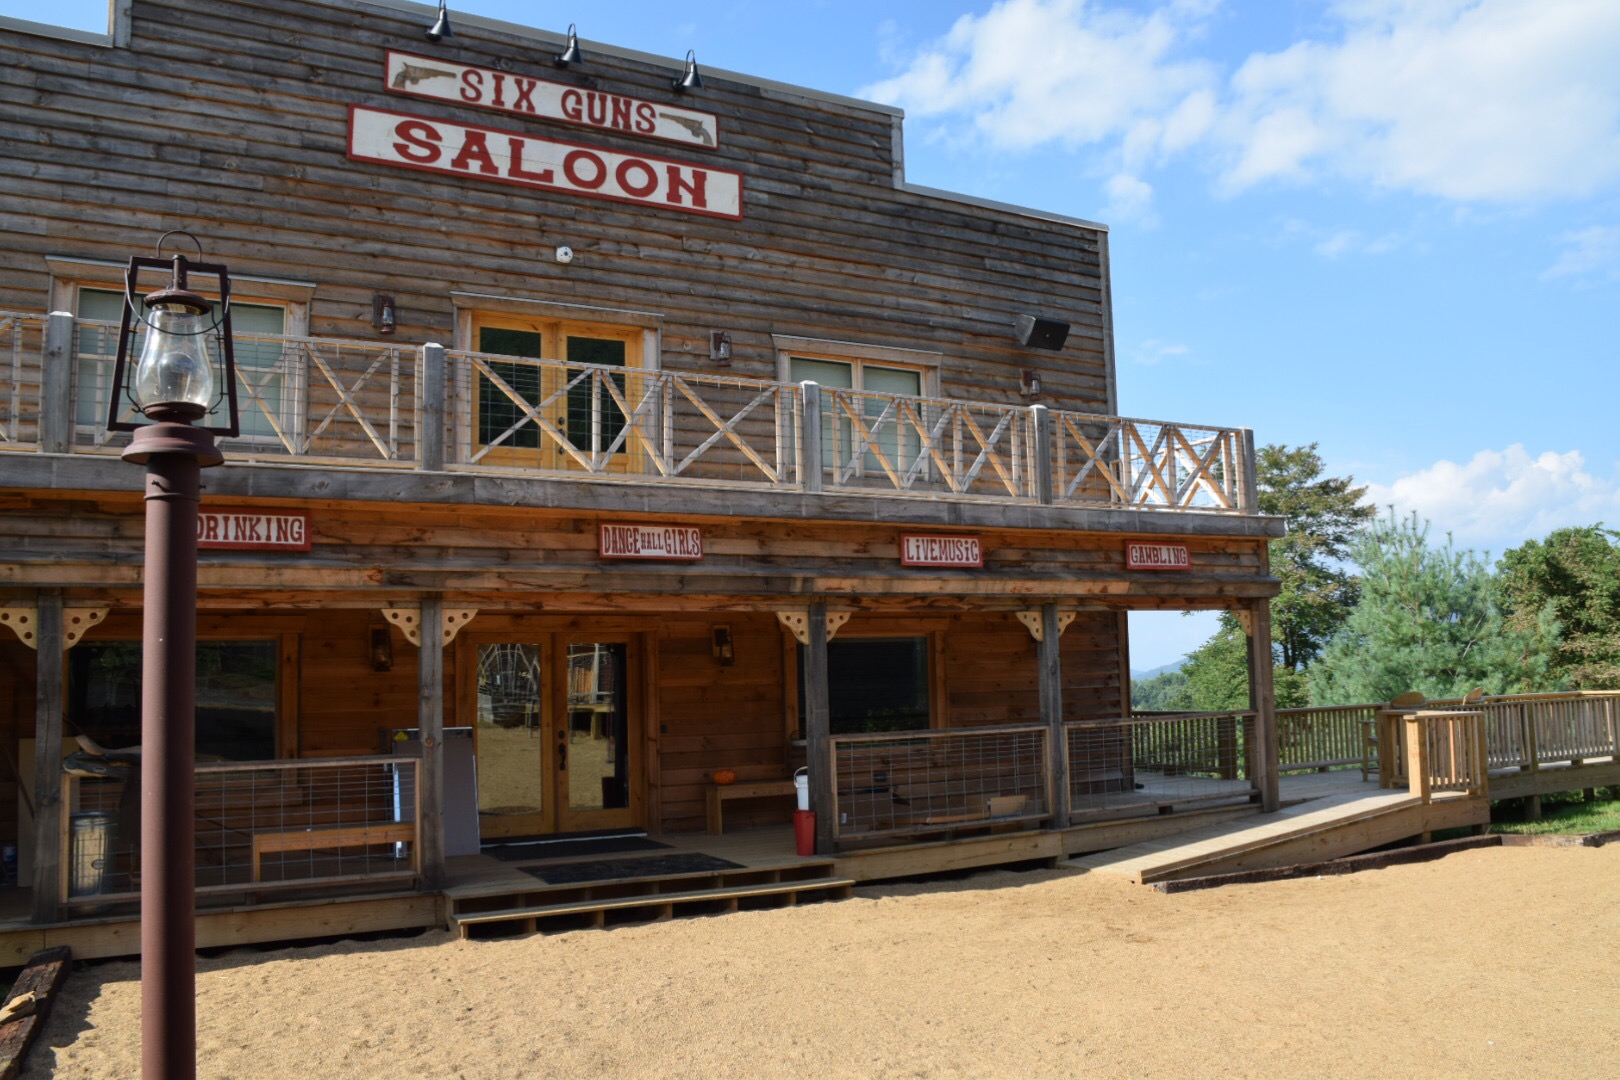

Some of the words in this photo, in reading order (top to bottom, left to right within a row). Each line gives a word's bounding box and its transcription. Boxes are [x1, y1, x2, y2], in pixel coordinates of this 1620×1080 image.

[460, 69, 537, 113] SIX
[561, 89, 656, 134] GUNS
[393, 120, 707, 208] SALOON
[603, 526, 640, 554] DANCE
[640, 532, 663, 550] HALL
[664, 528, 700, 556] GIRLS
[1130, 545, 1187, 564] GAMBLING
